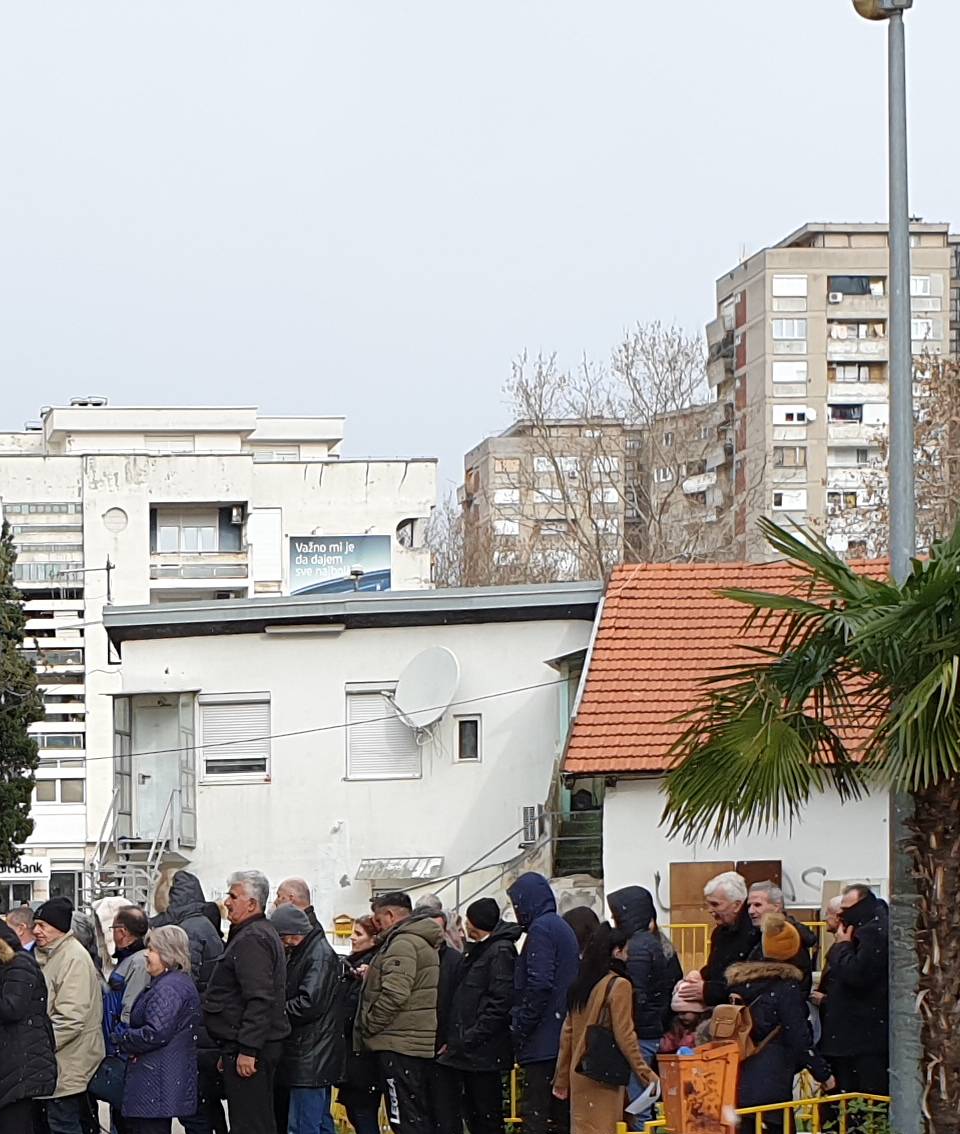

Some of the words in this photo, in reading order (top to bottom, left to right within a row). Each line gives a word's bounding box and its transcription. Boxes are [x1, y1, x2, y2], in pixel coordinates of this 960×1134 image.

[295, 541, 326, 553] Važno
[329, 541, 343, 553] mi
[344, 541, 355, 555] je
[295, 554, 308, 565] da
[310, 554, 343, 567] dajem
[295, 567, 312, 577] sve
[315, 565, 351, 578] najbolj
[14, 861, 43, 873] Bank
